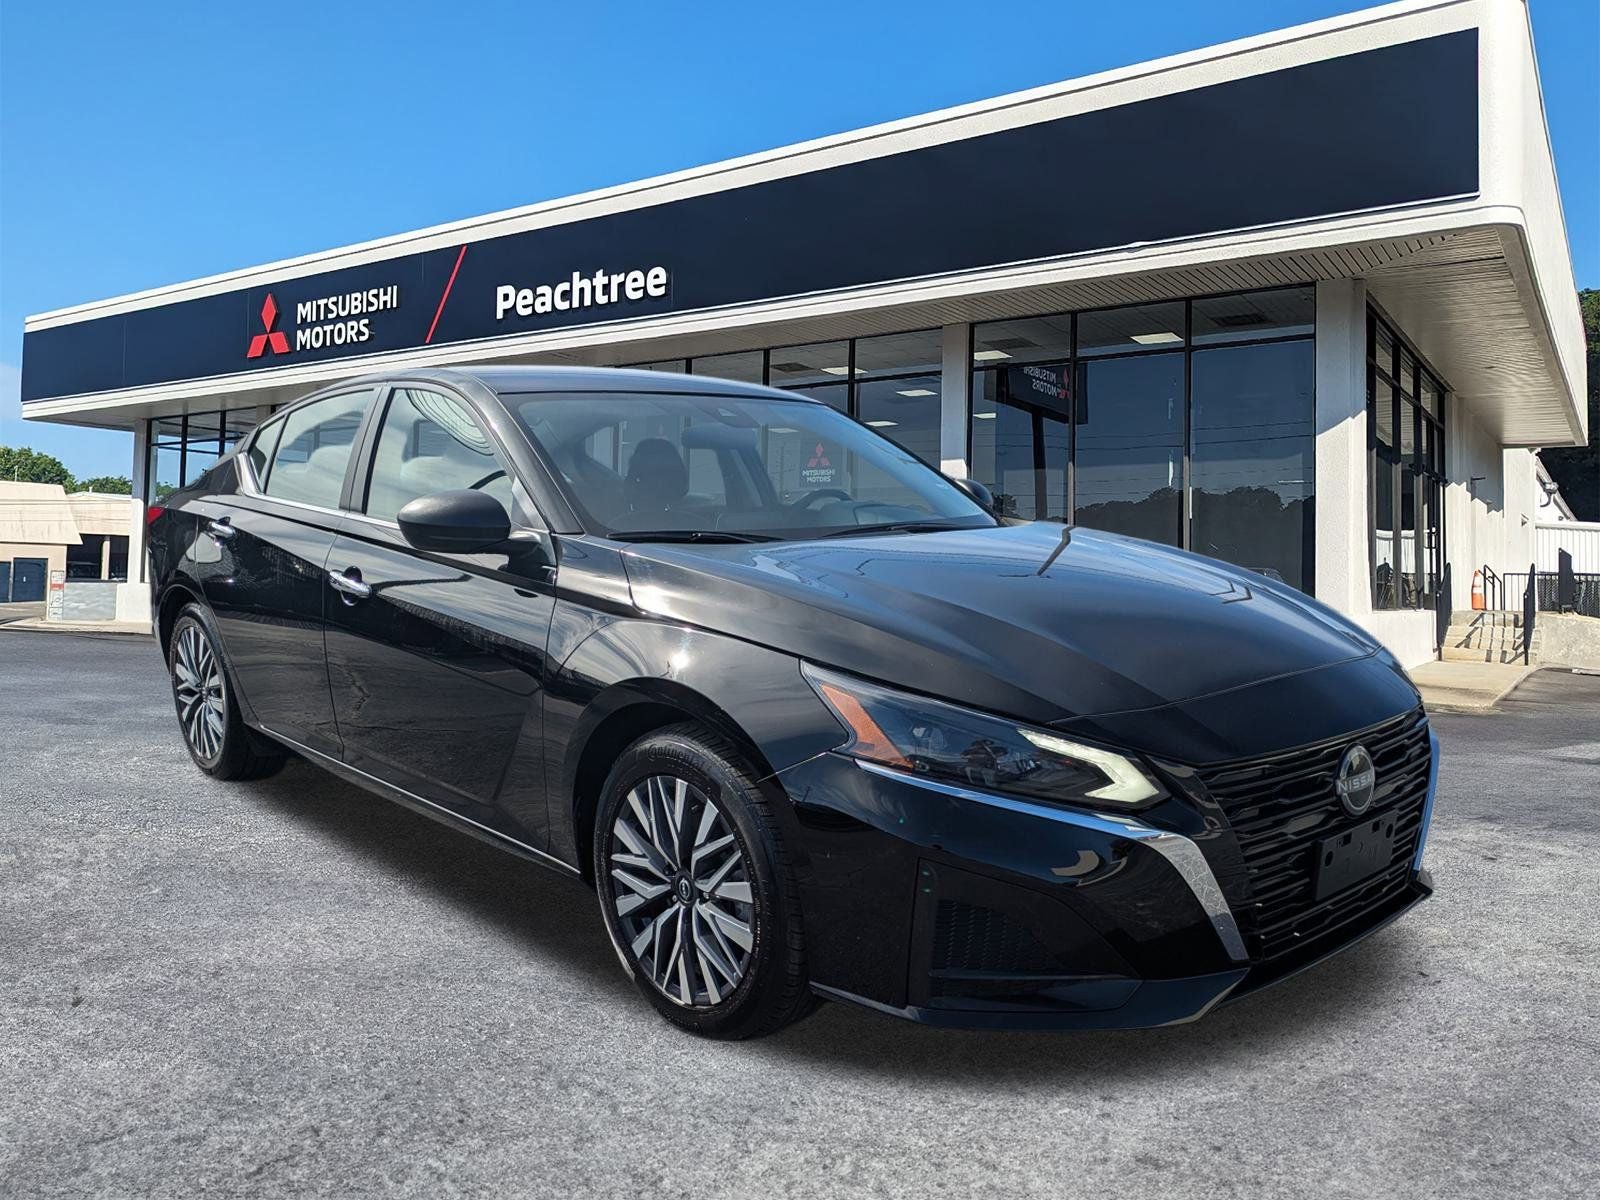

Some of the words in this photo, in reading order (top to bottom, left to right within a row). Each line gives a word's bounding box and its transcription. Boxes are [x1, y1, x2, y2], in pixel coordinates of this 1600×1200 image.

[296, 285, 398, 324] MITSUBISHI
[496, 266, 667, 320] Peachtree
[296, 319, 370, 351] MOTORS
[1337, 773, 1372, 793] NISSA
